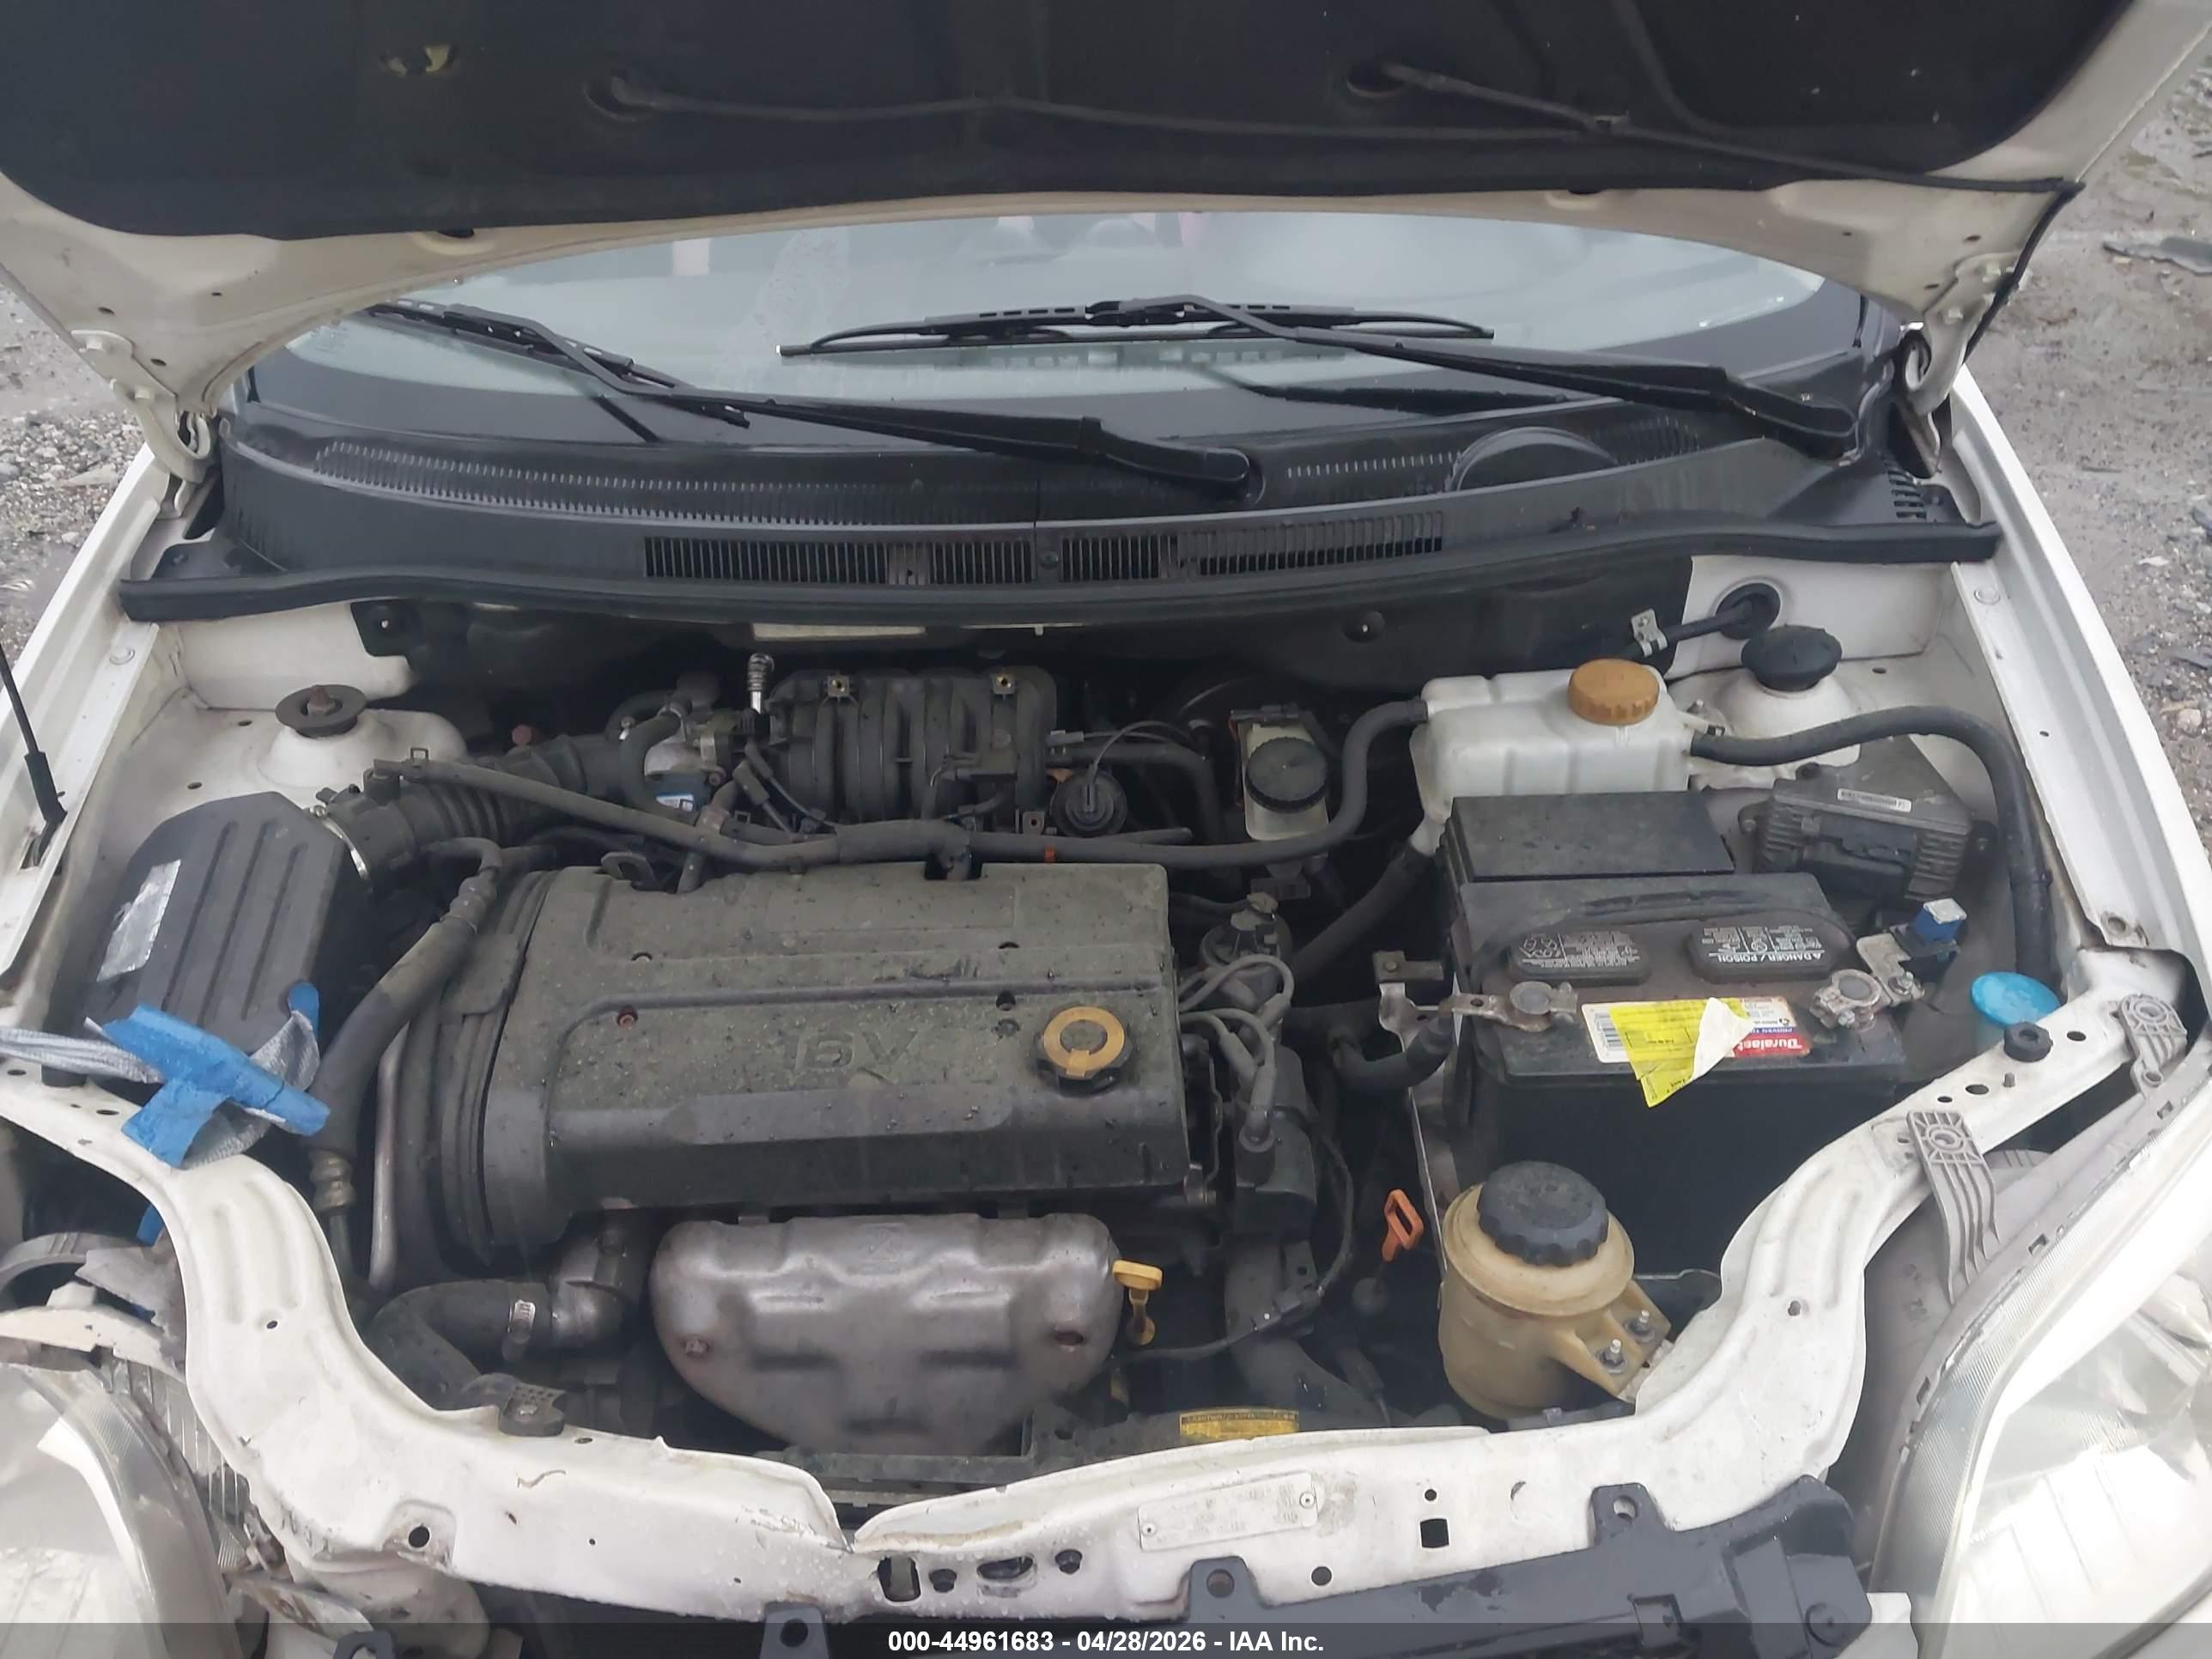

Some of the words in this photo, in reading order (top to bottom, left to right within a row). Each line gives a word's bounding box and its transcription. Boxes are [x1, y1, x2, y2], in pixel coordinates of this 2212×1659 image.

[1717, 953, 1758, 963] POISON
[1768, 952, 1812, 962] DANGER
[1738, 1038, 1803, 1051] Duralast
[782, 1030, 918, 1072] 16V
